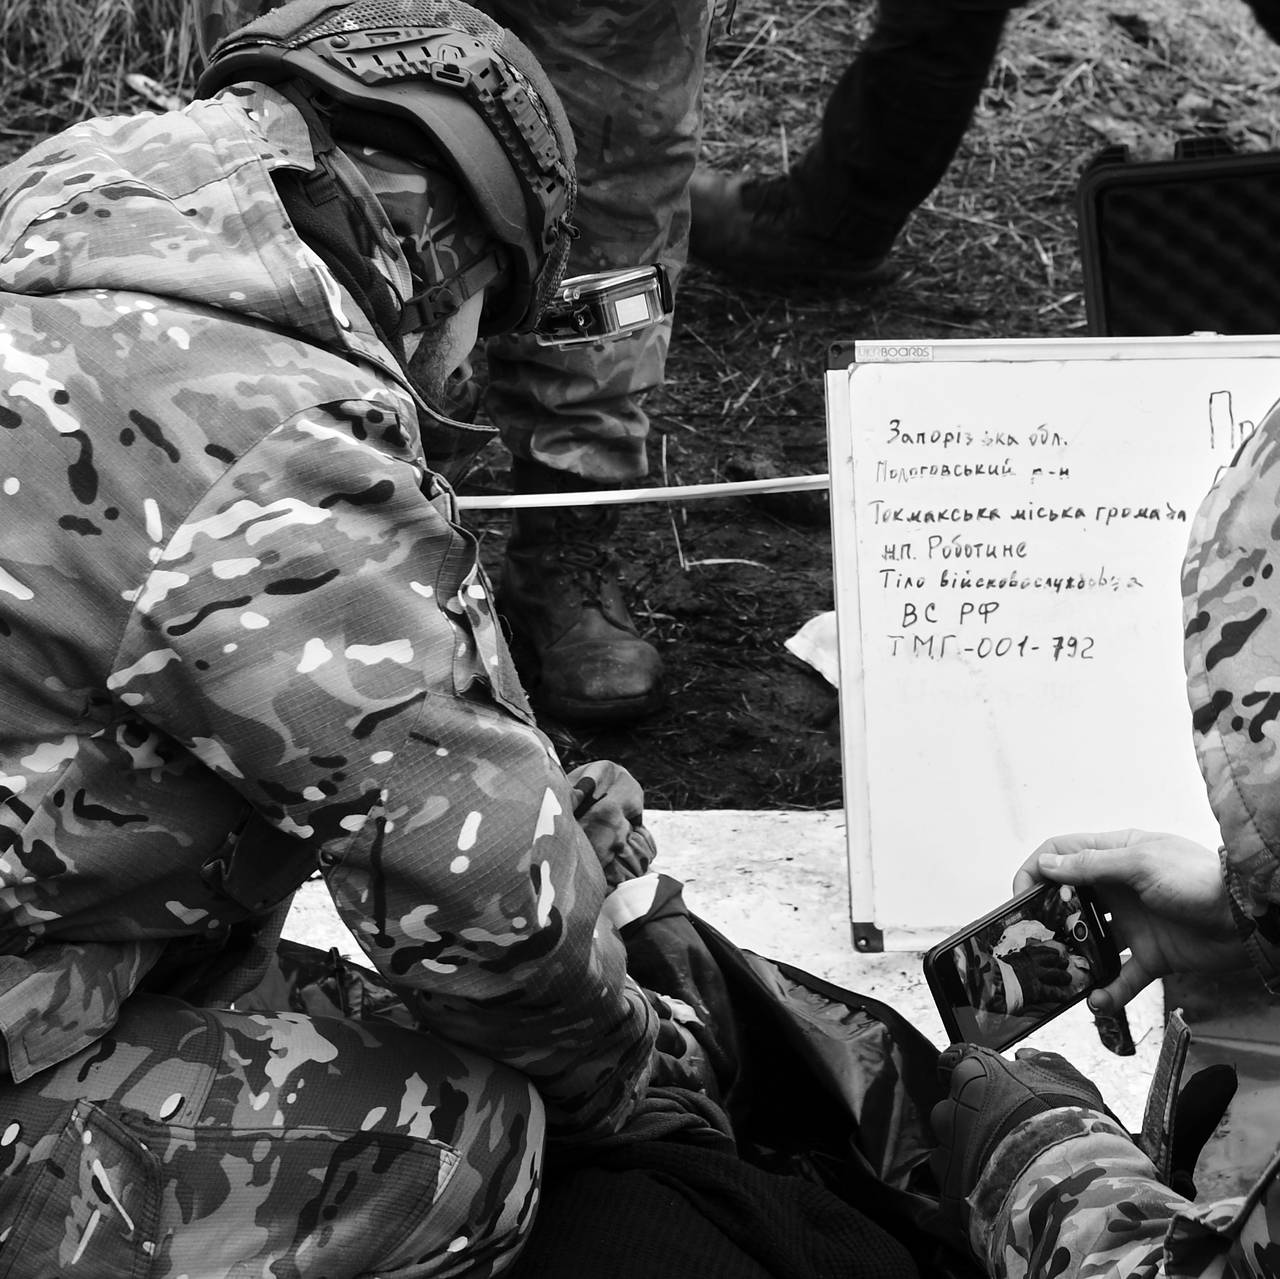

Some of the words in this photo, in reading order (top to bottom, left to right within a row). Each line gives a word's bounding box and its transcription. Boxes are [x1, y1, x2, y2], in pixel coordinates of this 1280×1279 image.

[1028, 423, 1068, 447] обл.
[868, 499, 1001, 525] Токмакська
[1011, 500, 1087, 522] міська
[1095, 501, 1187, 526] громада
[928, 534, 1028, 559] Роботине
[879, 568, 925, 589] Тіло
[901, 602, 938, 628] ВС
[959, 601, 1000, 625] РФ
